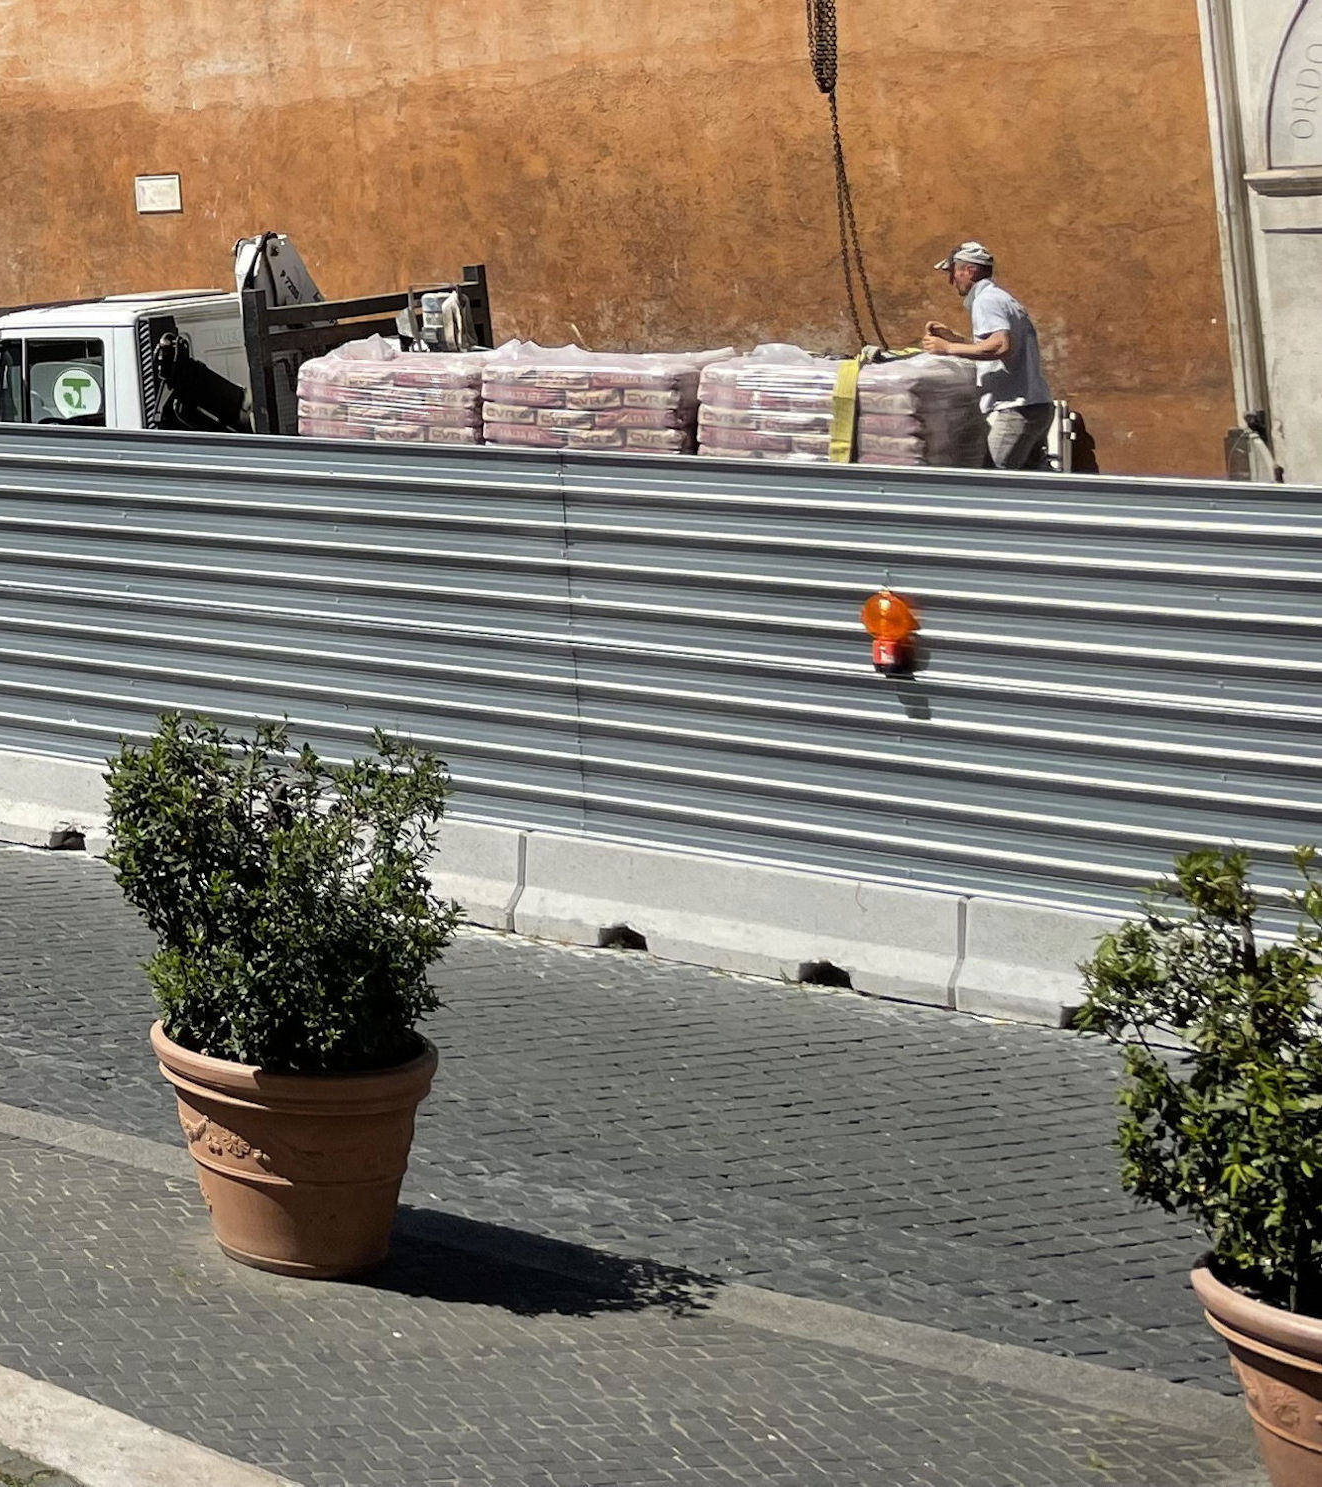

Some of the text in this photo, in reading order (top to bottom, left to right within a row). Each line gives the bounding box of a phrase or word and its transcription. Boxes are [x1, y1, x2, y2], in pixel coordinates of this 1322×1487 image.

[1289, 43, 1322, 140] ORDO
[627, 393, 659, 404] CVR
[486, 407, 516, 418] CVR
[629, 431, 662, 444] CVR
